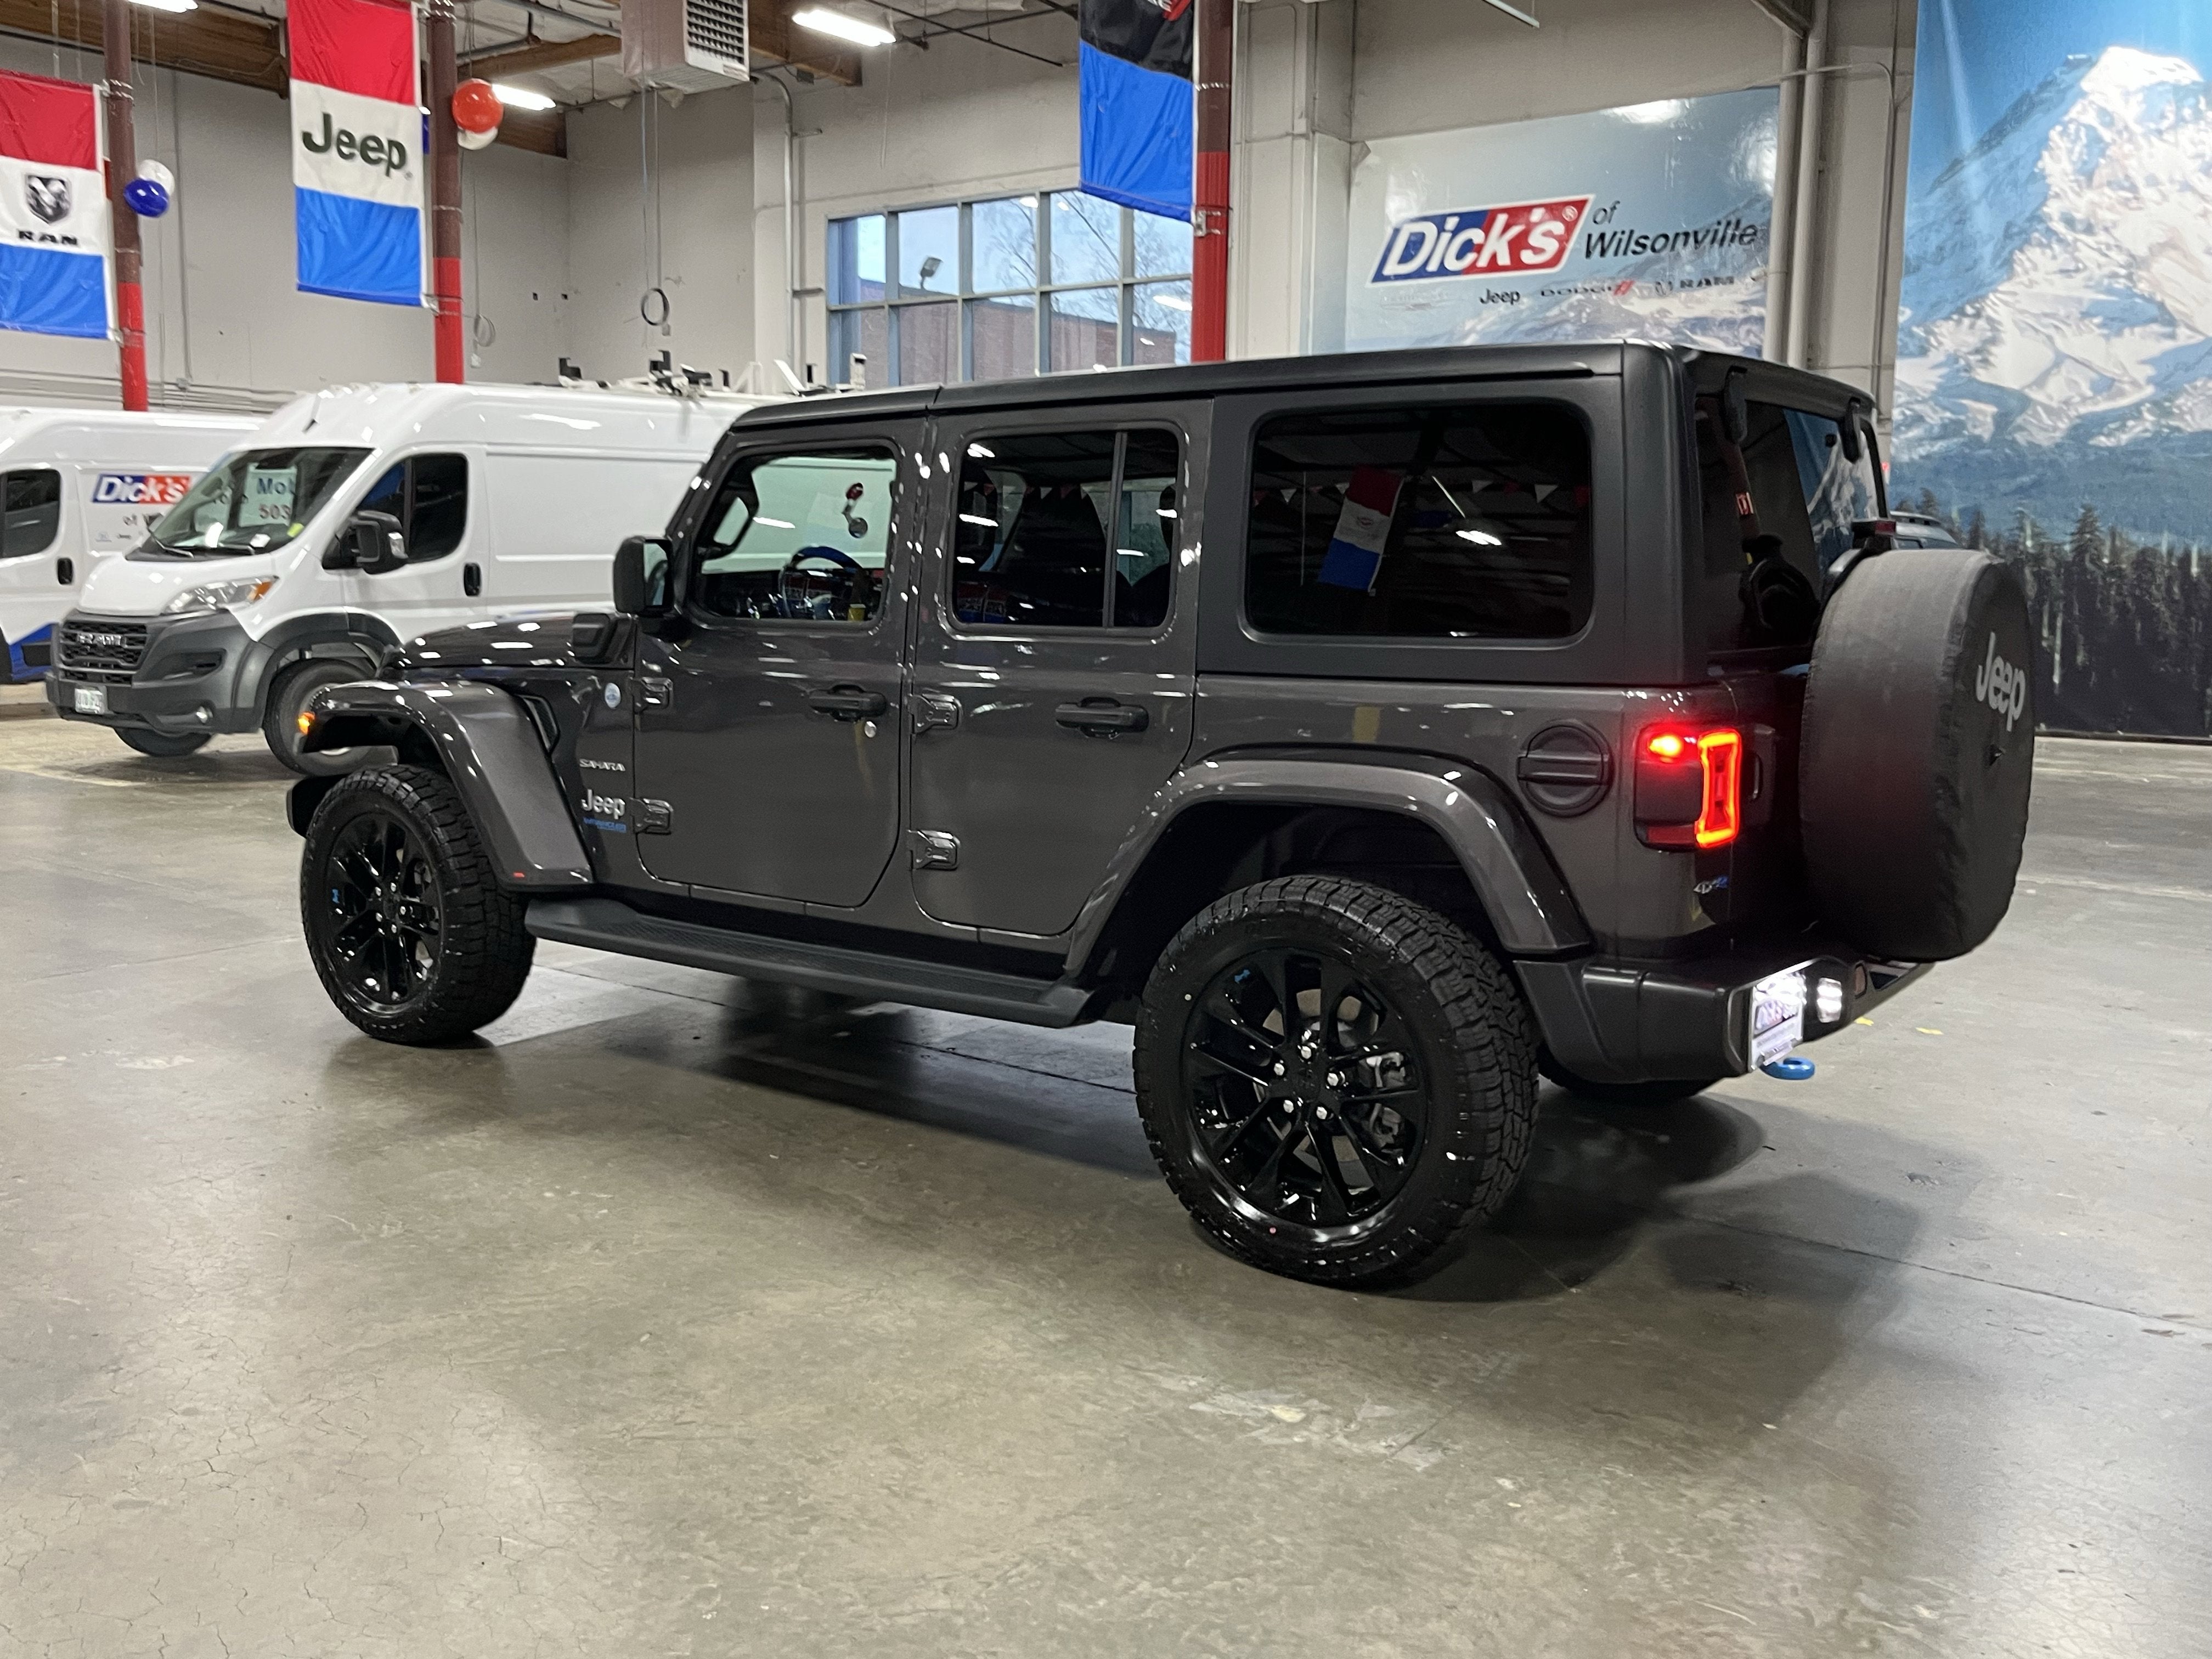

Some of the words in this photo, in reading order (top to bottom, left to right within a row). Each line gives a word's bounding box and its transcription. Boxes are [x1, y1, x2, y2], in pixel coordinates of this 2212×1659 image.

[302, 112, 406, 177] Jeep
[1592, 201, 1620, 225] of
[18, 230, 78, 245] RAM
[1382, 208, 1566, 276] Dick's
[1585, 219, 1758, 259] Wilsonville
[1480, 289, 1520, 304] Jeep
[1680, 276, 1734, 289] RAM
[1976, 632, 2025, 732] Jeep
[579, 758, 625, 771] SAHARA
[581, 789, 625, 820] Jeep
